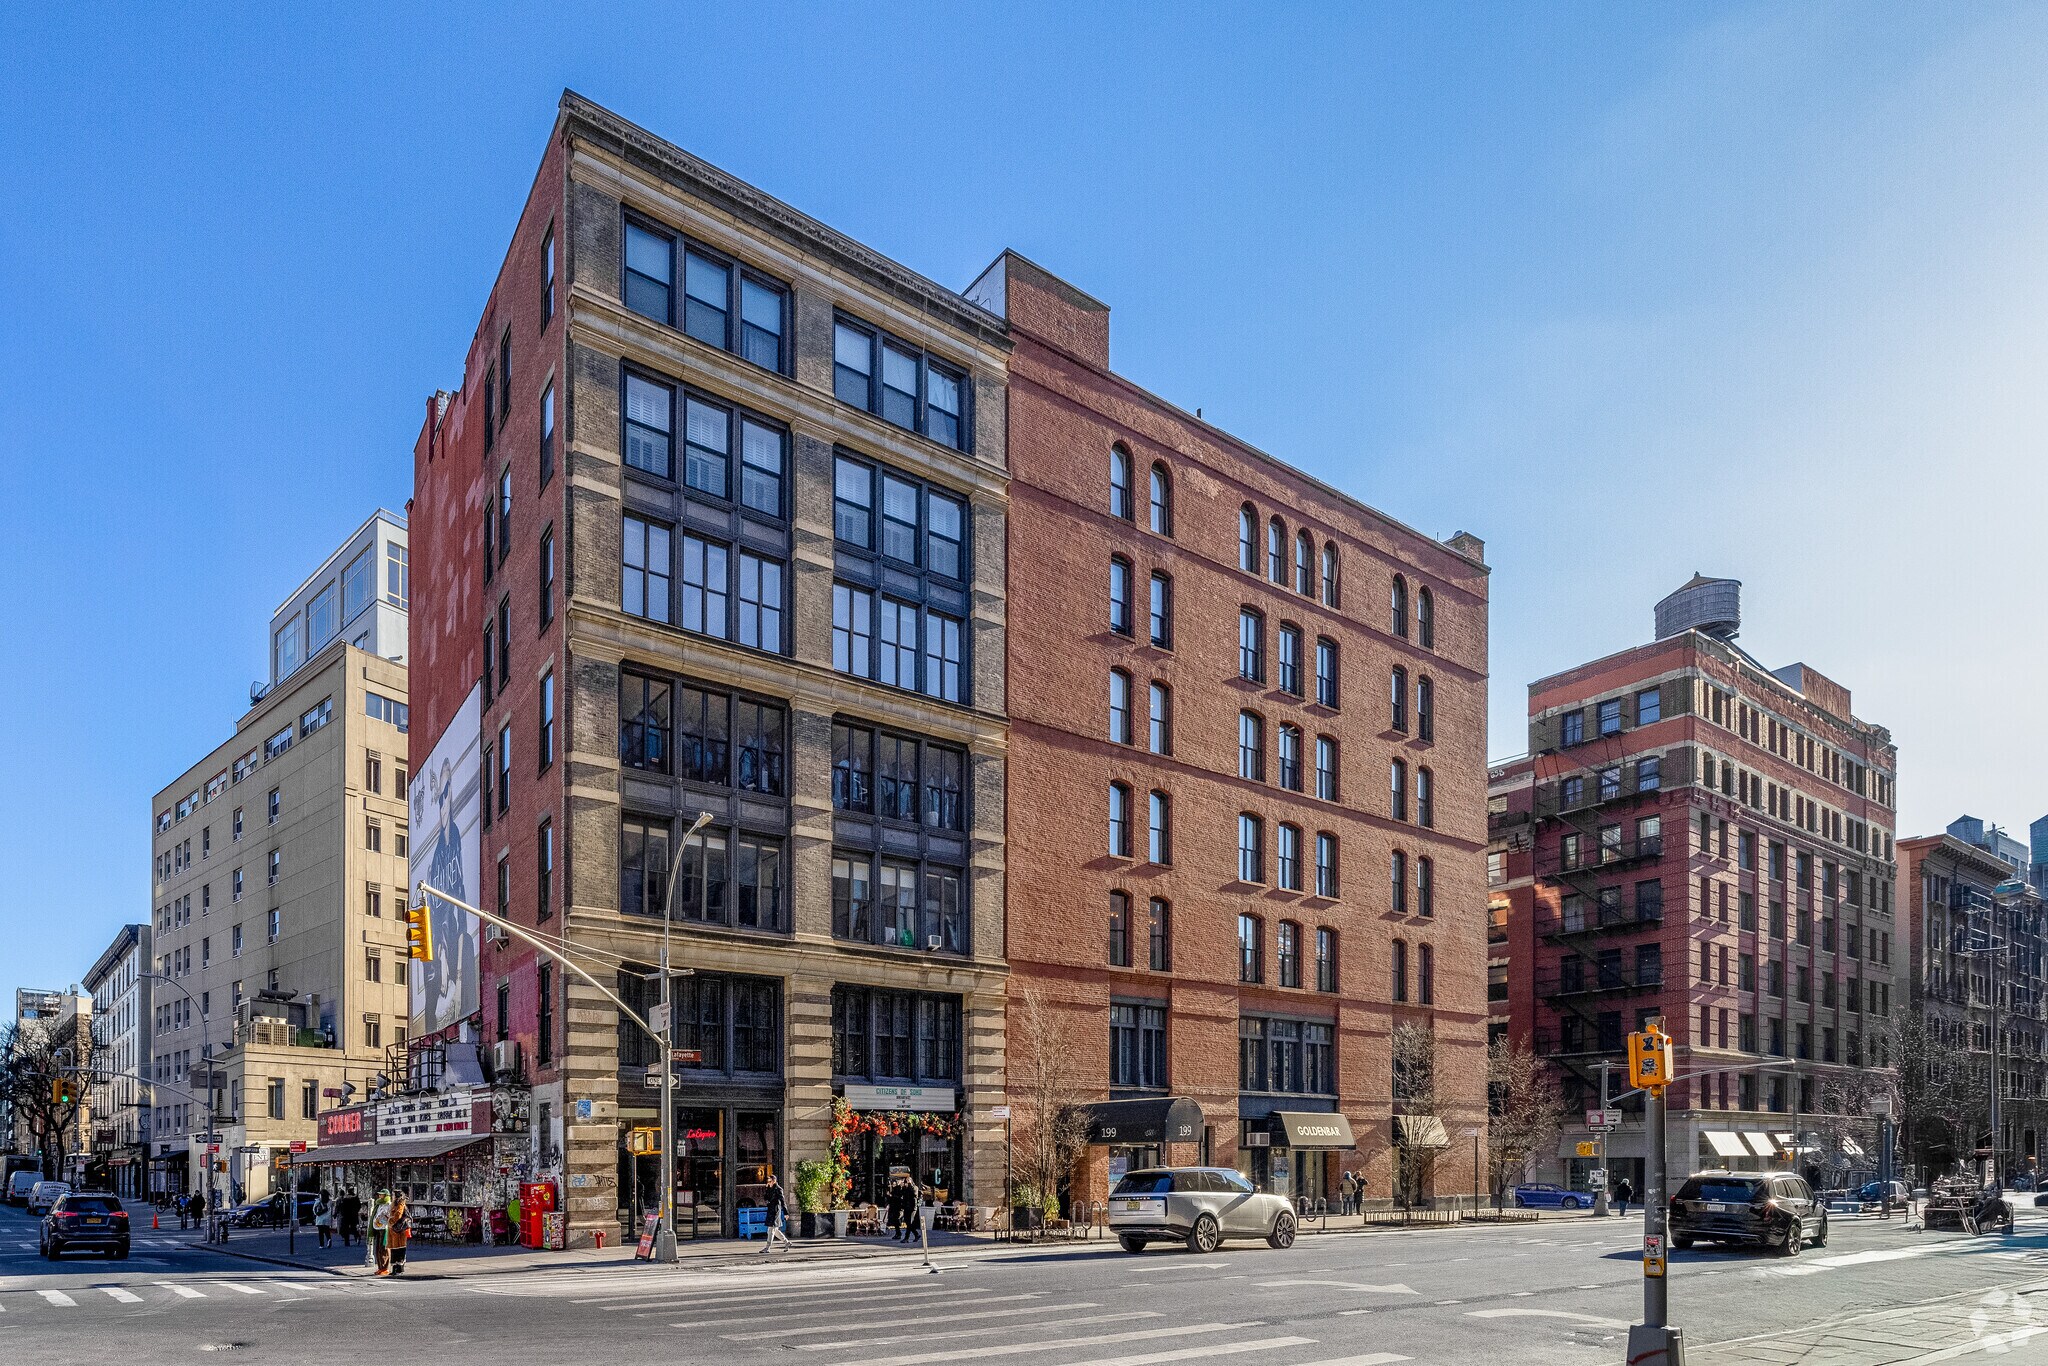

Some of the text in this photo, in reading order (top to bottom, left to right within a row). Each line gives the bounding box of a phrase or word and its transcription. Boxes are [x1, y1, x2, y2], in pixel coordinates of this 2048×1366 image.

[671, 1051, 694, 1059] Lafayette
[327, 1112, 361, 1135] CORNER
[1101, 1127, 1117, 1138] 199
[1179, 1124, 1192, 1136] 199
[1297, 1126, 1341, 1136] GOLDENBAR
